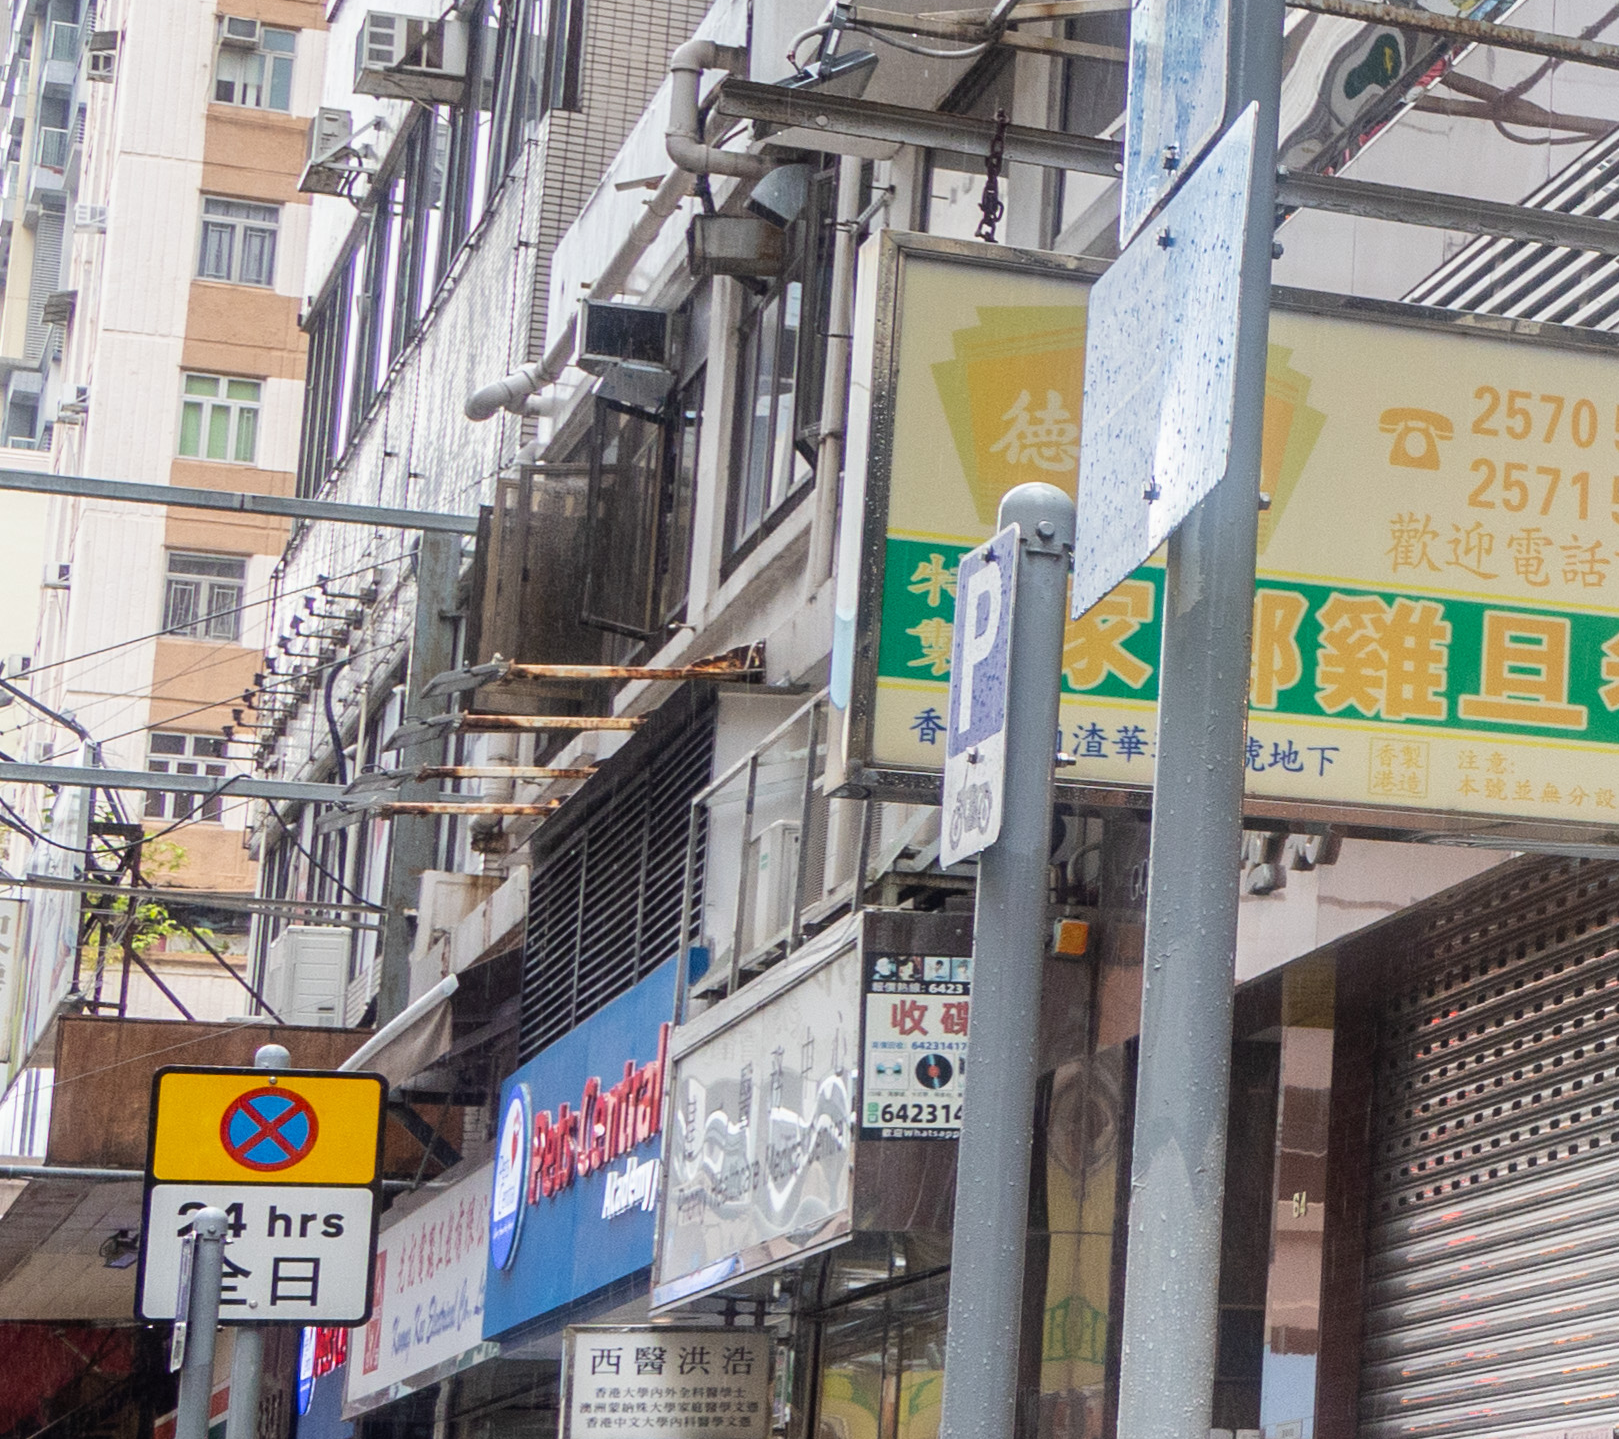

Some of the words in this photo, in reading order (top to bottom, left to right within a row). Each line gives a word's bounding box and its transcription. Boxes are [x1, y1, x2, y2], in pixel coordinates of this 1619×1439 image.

[1472, 385, 1598, 449] 2570
[1467, 458, 1593, 522] 2571
[958, 560, 1002, 735] P
[267, 1205, 345, 1238] hrs
[590, 1346, 753, 1376] 西醫洪浩
